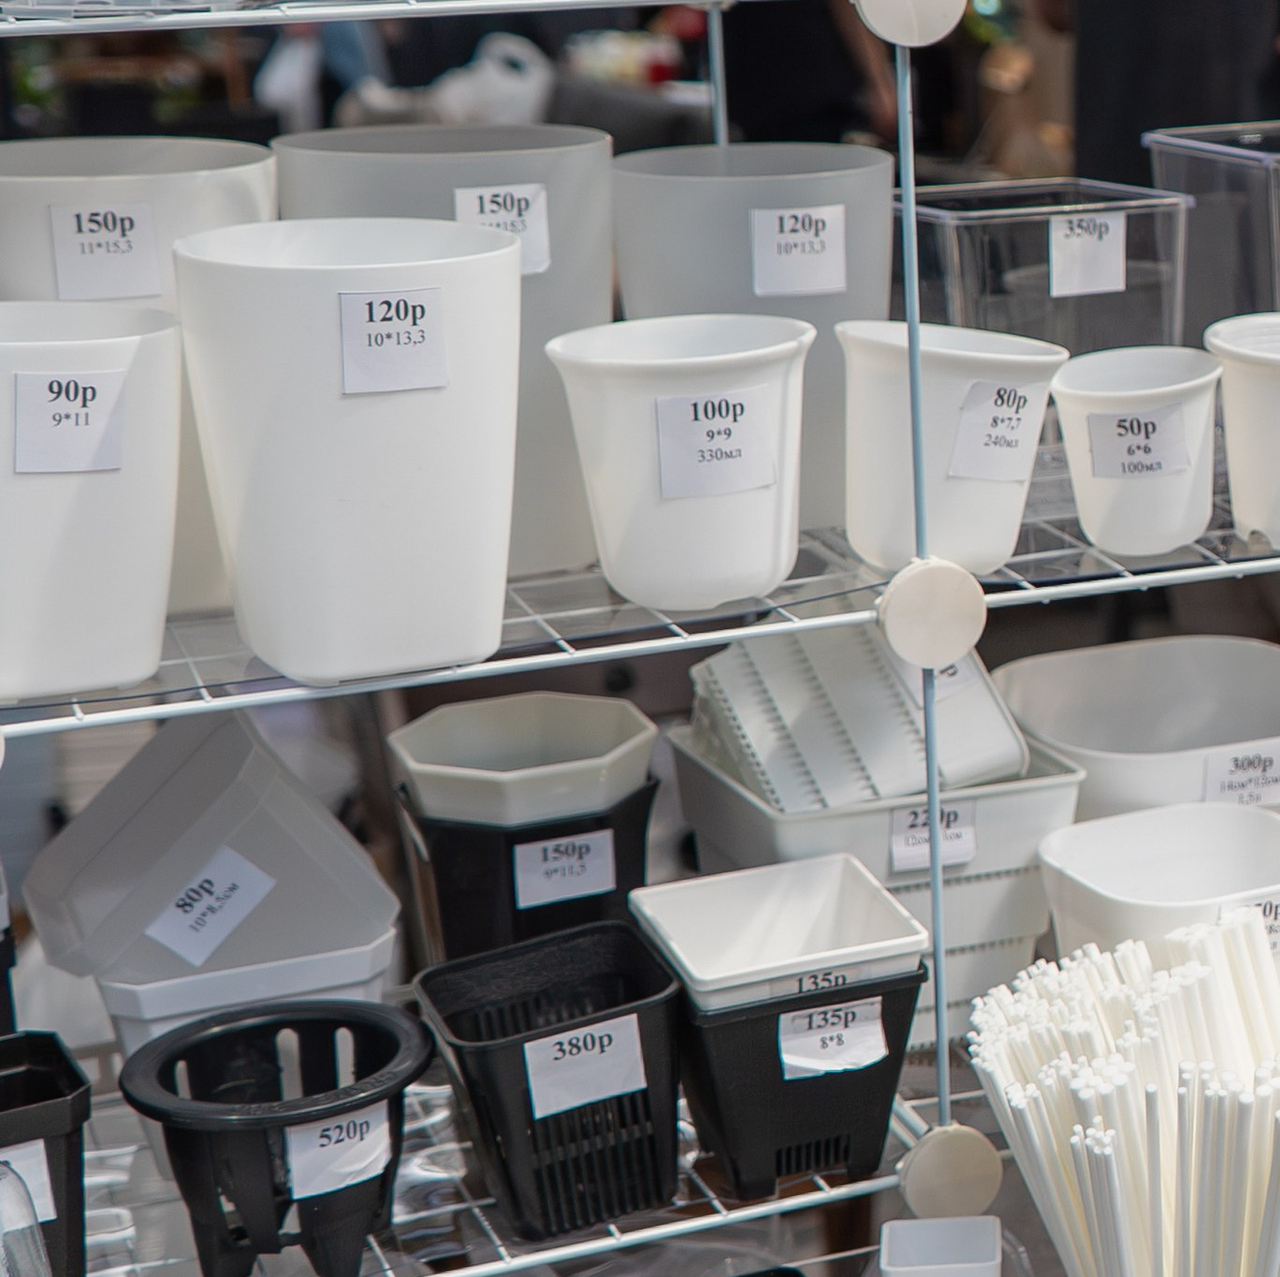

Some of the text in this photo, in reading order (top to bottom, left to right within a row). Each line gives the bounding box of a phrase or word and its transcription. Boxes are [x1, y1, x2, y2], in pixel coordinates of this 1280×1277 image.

[478, 191, 530, 218] 150р
[74, 210, 136, 238] 150р
[777, 212, 827, 238] 120р
[1063, 218, 1111, 241] 350р
[364, 298, 427, 326] 120р
[48, 378, 98, 409] 90р
[993, 387, 1028, 413] 80р
[691, 399, 745, 423] 100р
[1116, 418, 1157, 440] 50р
[697, 446, 743, 463] 330мл
[1230, 753, 1273, 775] 300р
[541, 843, 592, 865] 150р
[175, 878, 216, 915] 80р
[806, 1009, 856, 1032] 135р
[553, 1029, 613, 1062] 380р
[319, 1119, 371, 1148] 520р
